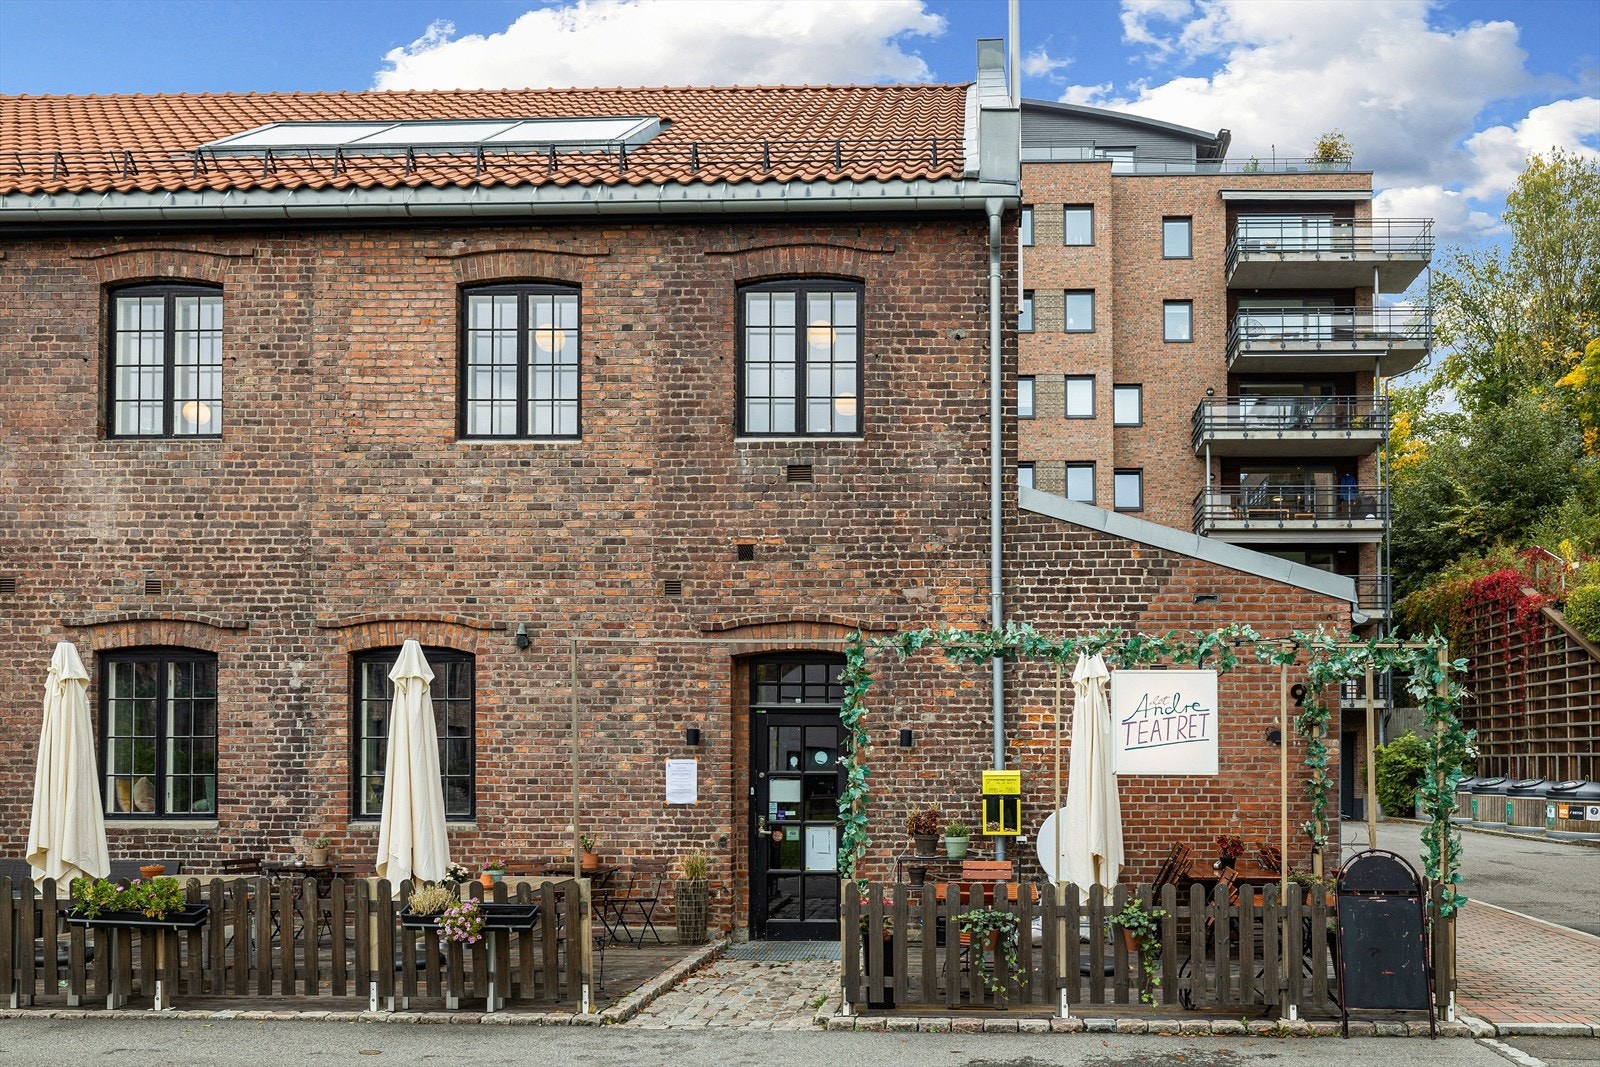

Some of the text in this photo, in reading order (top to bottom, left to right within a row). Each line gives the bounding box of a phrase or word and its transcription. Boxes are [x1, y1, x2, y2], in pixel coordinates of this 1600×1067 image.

[1122, 692, 1210, 722] Andre
[1291, 684, 1307, 707] 9
[1121, 713, 1210, 745] TEATRET
